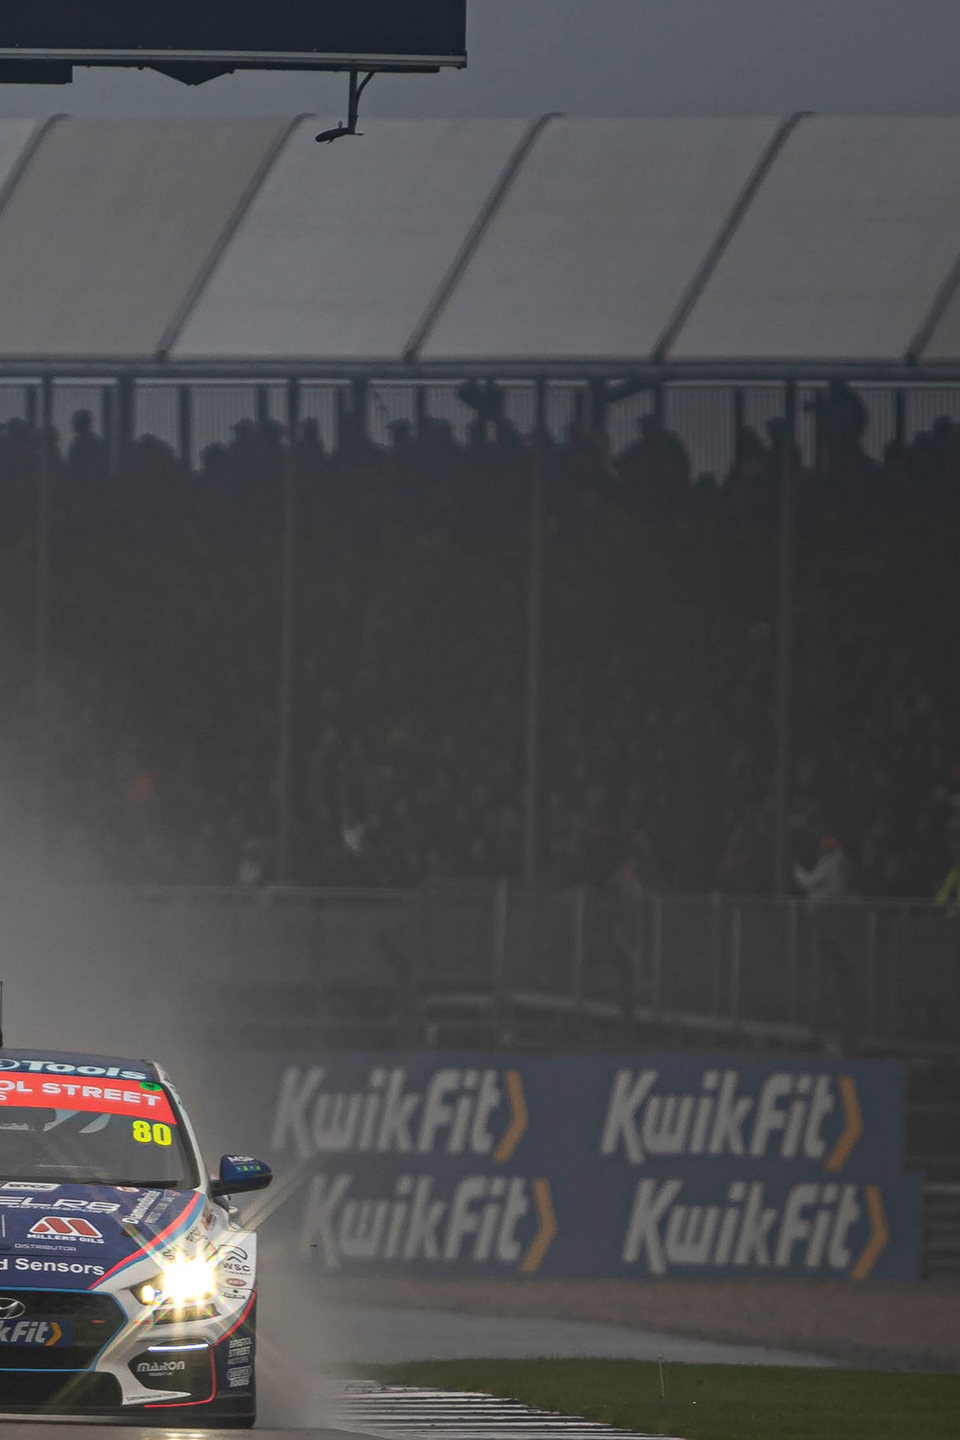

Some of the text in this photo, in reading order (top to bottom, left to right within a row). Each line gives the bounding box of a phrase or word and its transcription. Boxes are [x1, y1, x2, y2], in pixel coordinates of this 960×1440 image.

[21, 1060, 147, 1080] Tools
[41, 1082, 162, 1106] STREET
[132, 1119, 172, 1147] 80
[14, 1242, 77, 1252] DISTRIBUTOR
[26, 1233, 105, 1245] MILLERS OILS
[14, 1257, 105, 1276] Sensors
